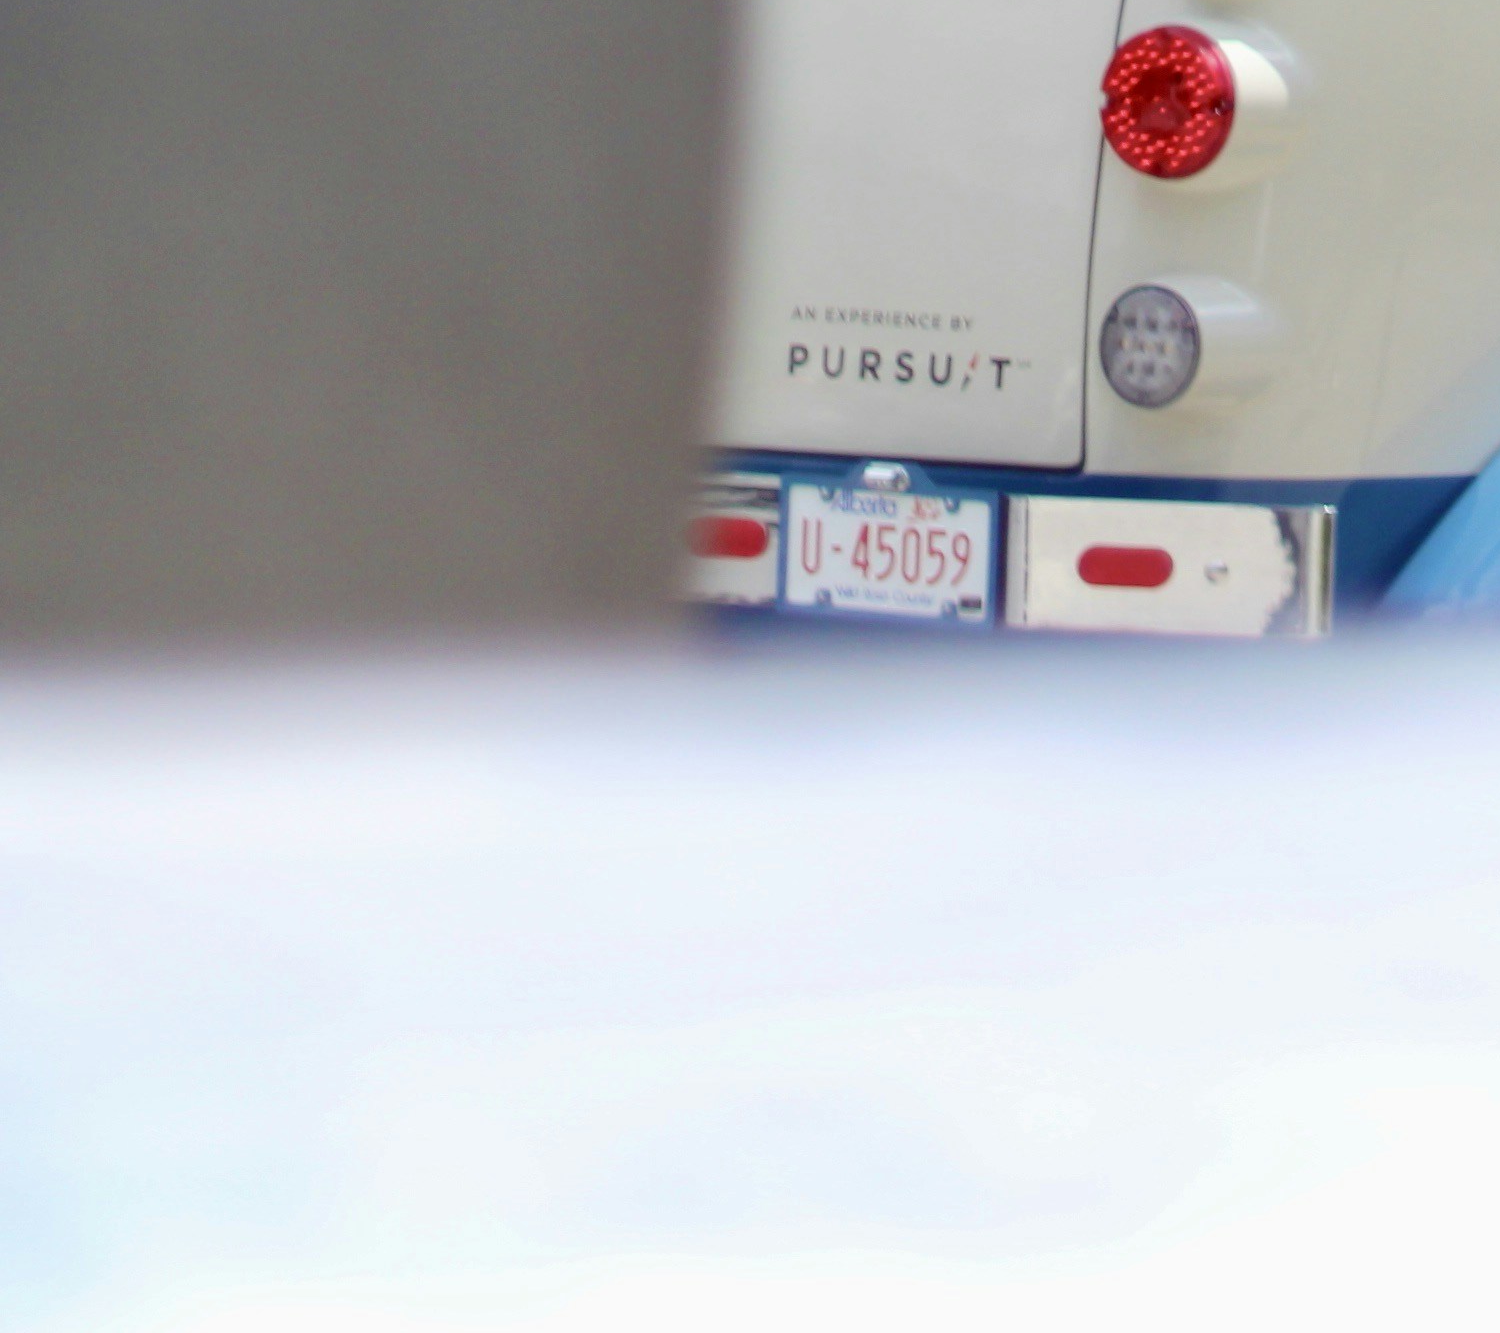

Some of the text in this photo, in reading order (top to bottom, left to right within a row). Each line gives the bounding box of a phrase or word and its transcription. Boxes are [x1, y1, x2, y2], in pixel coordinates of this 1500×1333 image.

[790, 305, 975, 331] AN EXPERIENCE BY
[801, 517, 971, 587] U-45059
